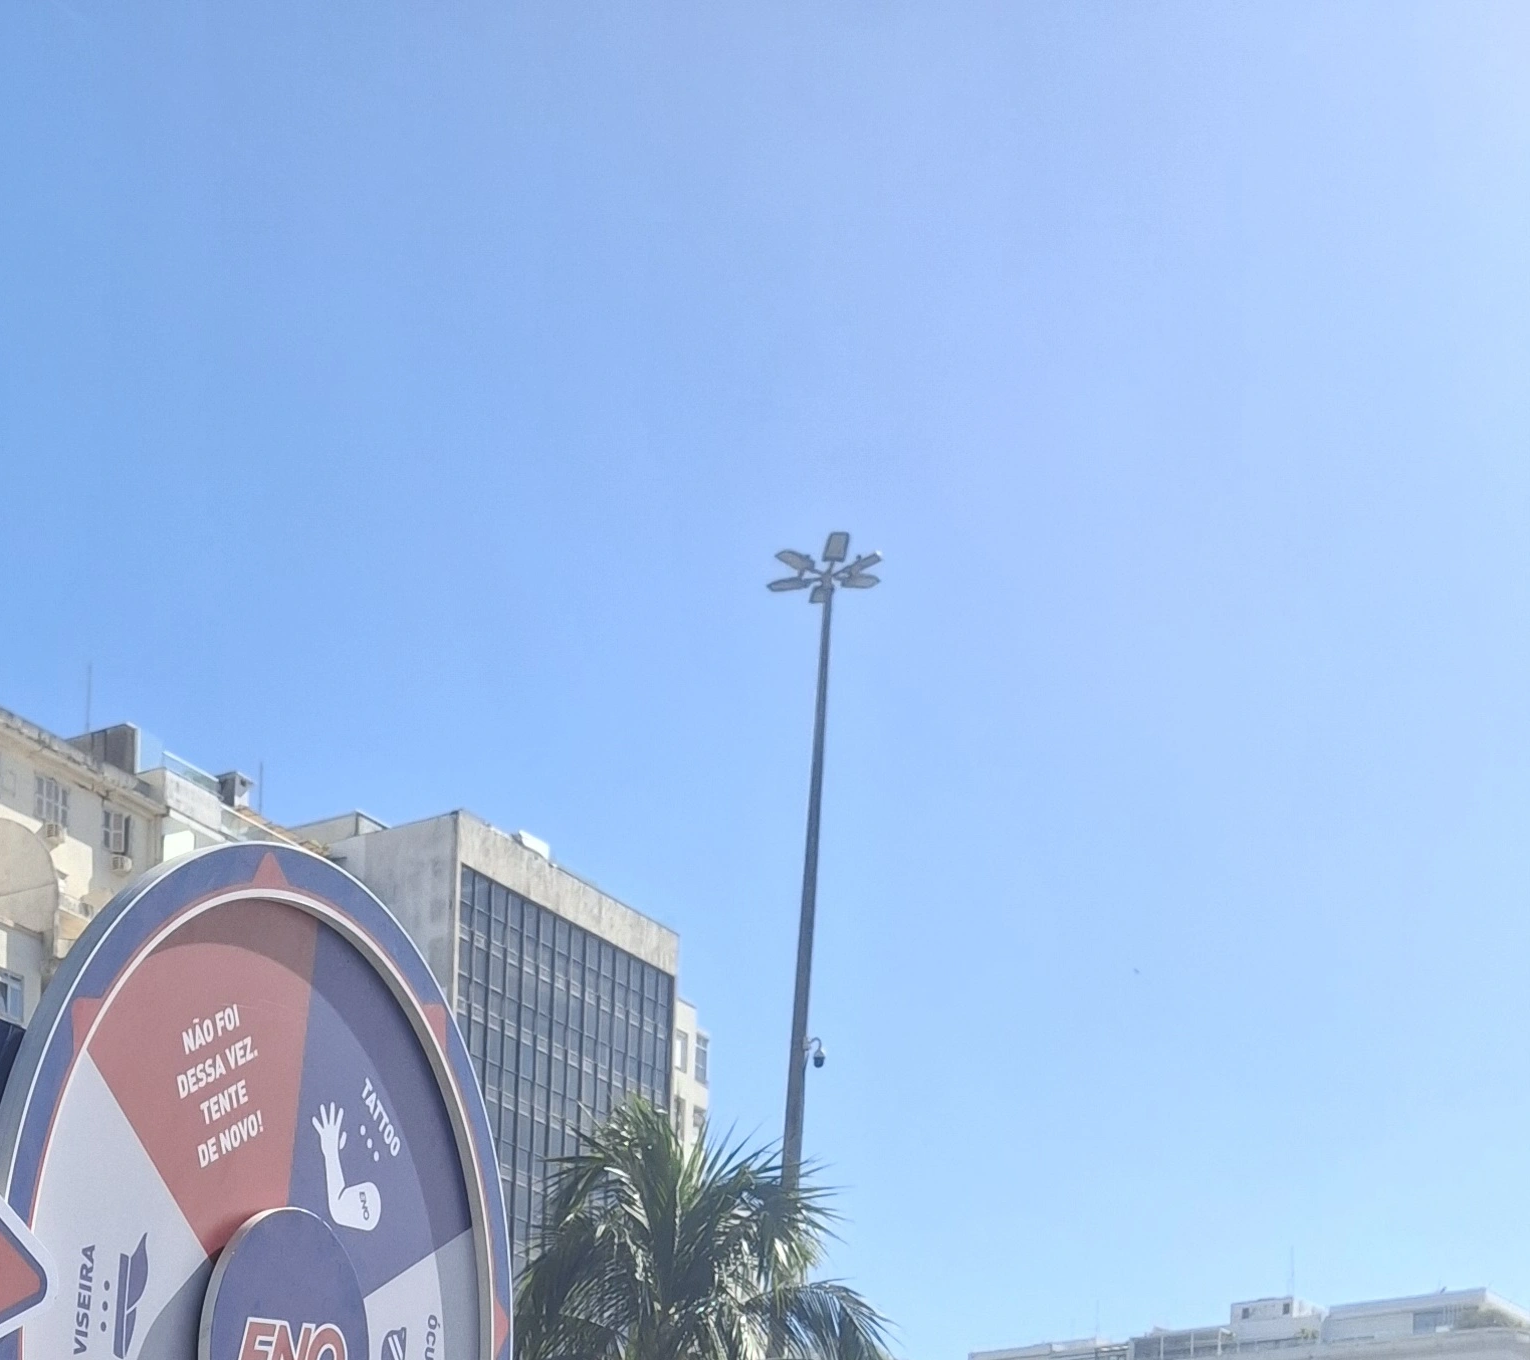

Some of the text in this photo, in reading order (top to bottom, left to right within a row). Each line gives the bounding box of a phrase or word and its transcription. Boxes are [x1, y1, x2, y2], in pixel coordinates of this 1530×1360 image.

[181, 1004, 240, 1055] NÃO FOI
[176, 1036, 258, 1099] DESSA VEZ.
[199, 1079, 249, 1125] TENTE
[361, 1077, 401, 1157] TATTOO
[197, 1109, 264, 1168] DE NOVO!
[359, 1191, 370, 1221] ENO
[73, 1244, 95, 1355] VISEIRA
